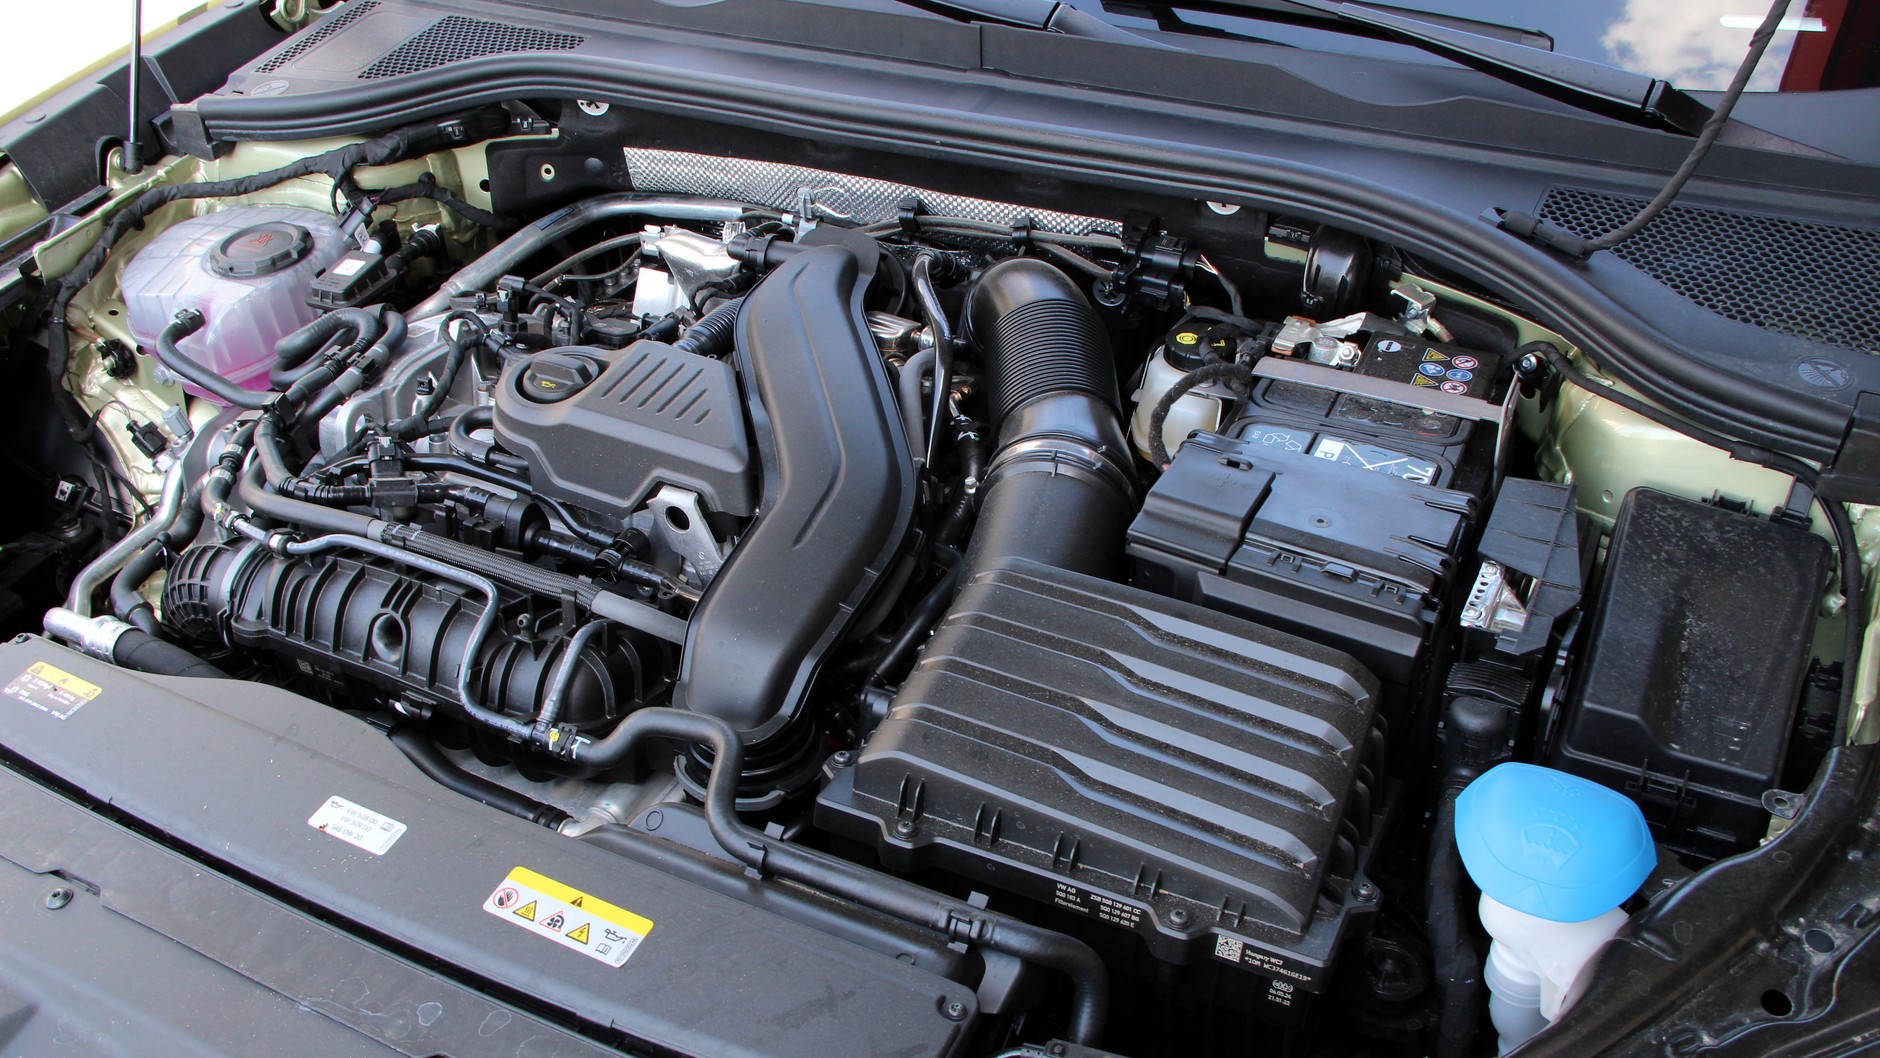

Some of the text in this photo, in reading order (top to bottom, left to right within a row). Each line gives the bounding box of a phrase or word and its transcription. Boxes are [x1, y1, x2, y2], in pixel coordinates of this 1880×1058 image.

[347, 808, 378, 825] VW 508 00
[340, 815, 372, 832] VW 509 00
[331, 823, 364, 841] SAE 0W-20
[1056, 883, 1067, 891] VW
[1113, 901, 1123, 909] 129
[1111, 908, 1121, 916] 129
[1110, 915, 1120, 923] 129
